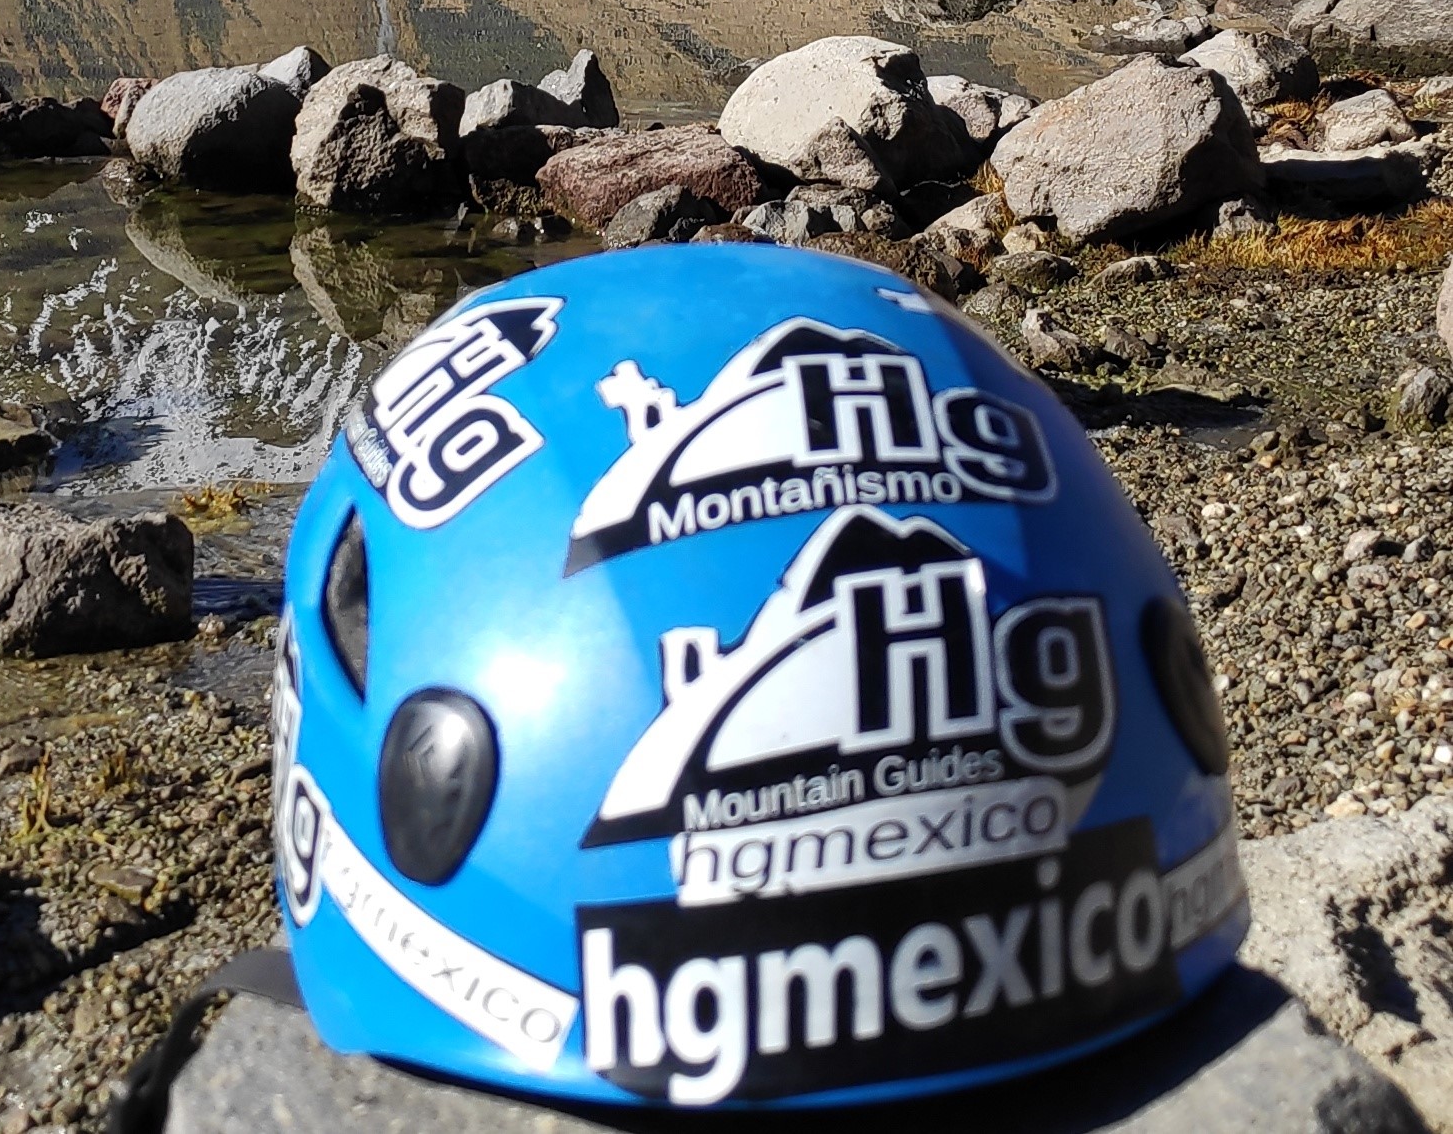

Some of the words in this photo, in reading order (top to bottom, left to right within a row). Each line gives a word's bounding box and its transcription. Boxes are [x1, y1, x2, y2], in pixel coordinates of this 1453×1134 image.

[782, 353, 1058, 501] Hg
[648, 464, 962, 544] Montañismo
[834, 557, 1116, 772] Hg
[678, 790, 1060, 892] hgmexico
[683, 763, 865, 832] Mountain
[873, 745, 1005, 798] Guides
[581, 861, 1167, 1106] hgmexico
